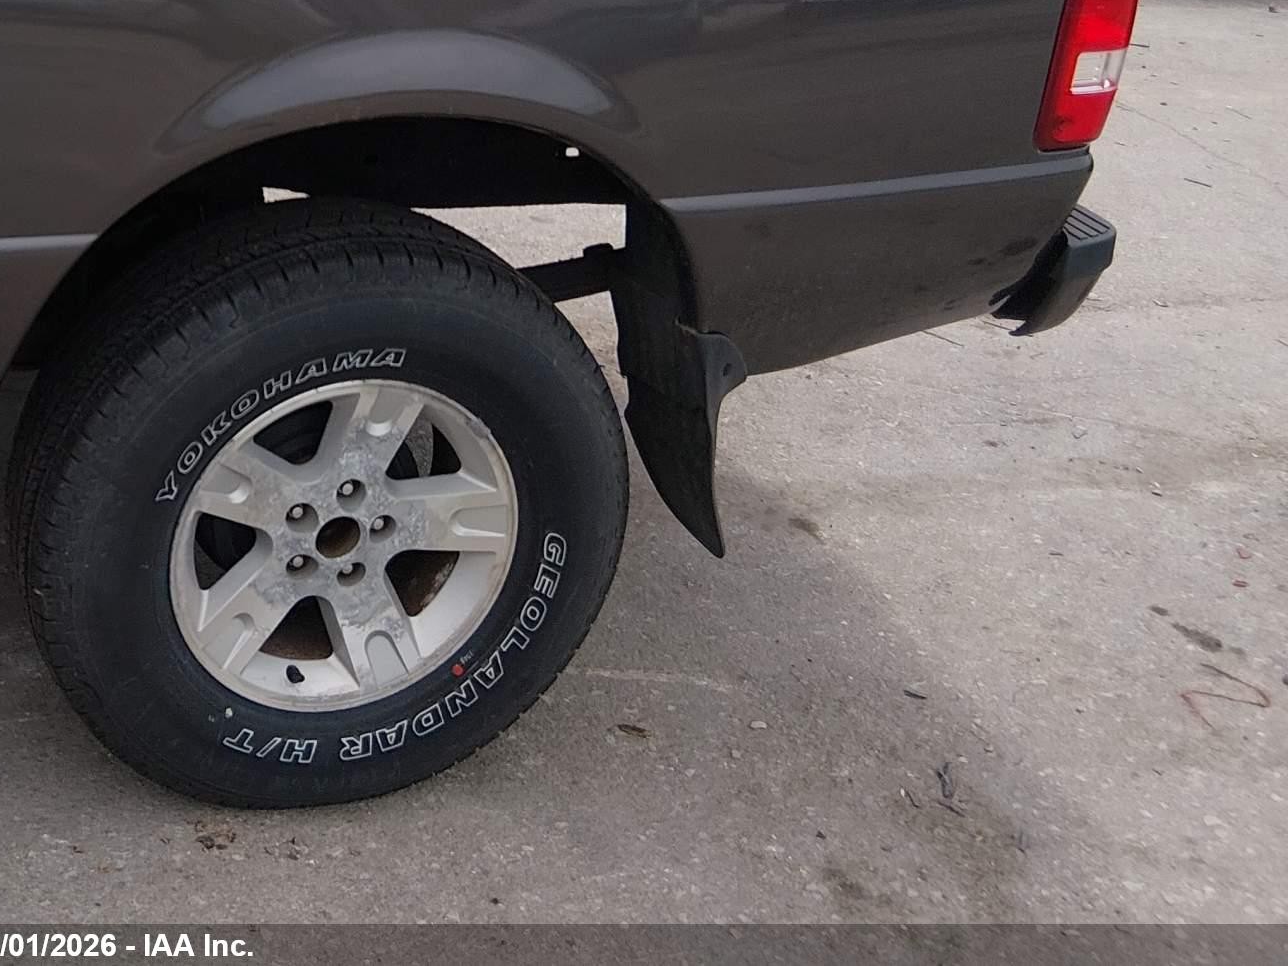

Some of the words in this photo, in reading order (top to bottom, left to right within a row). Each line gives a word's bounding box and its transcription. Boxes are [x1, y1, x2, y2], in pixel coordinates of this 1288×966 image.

[155, 348, 407, 502] YOKOHAMA
[339, 532, 567, 761] GEOLANDAR
[222, 727, 318, 764] H/T
